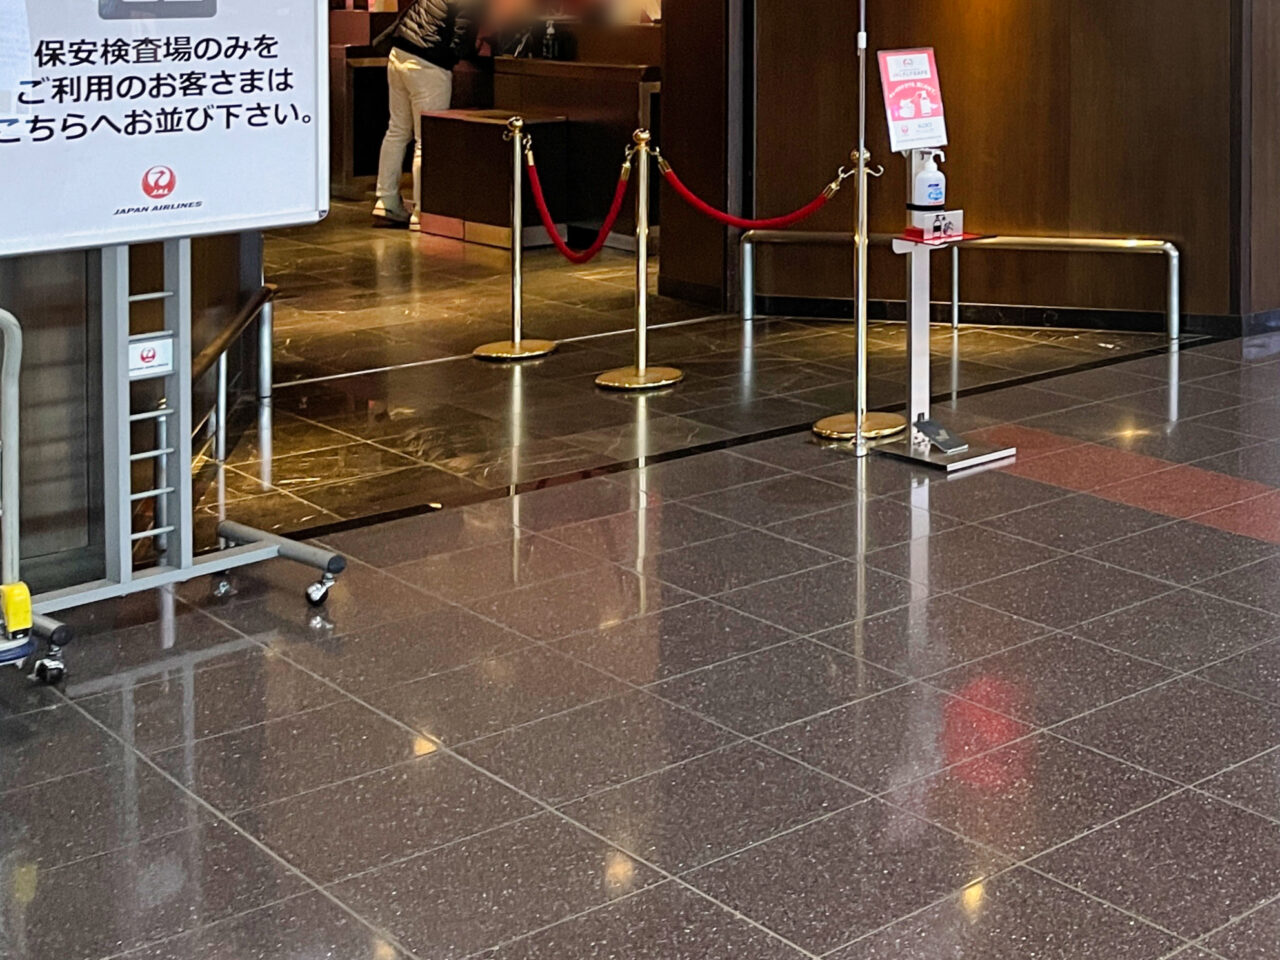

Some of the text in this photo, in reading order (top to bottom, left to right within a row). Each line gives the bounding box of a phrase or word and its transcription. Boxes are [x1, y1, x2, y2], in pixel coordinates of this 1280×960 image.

[34, 34, 279, 68] 保安検査場のみを
[17, 67, 294, 106] ご利用のお客さまは
[113, 200, 203, 216] JAPAN AIRLINES
